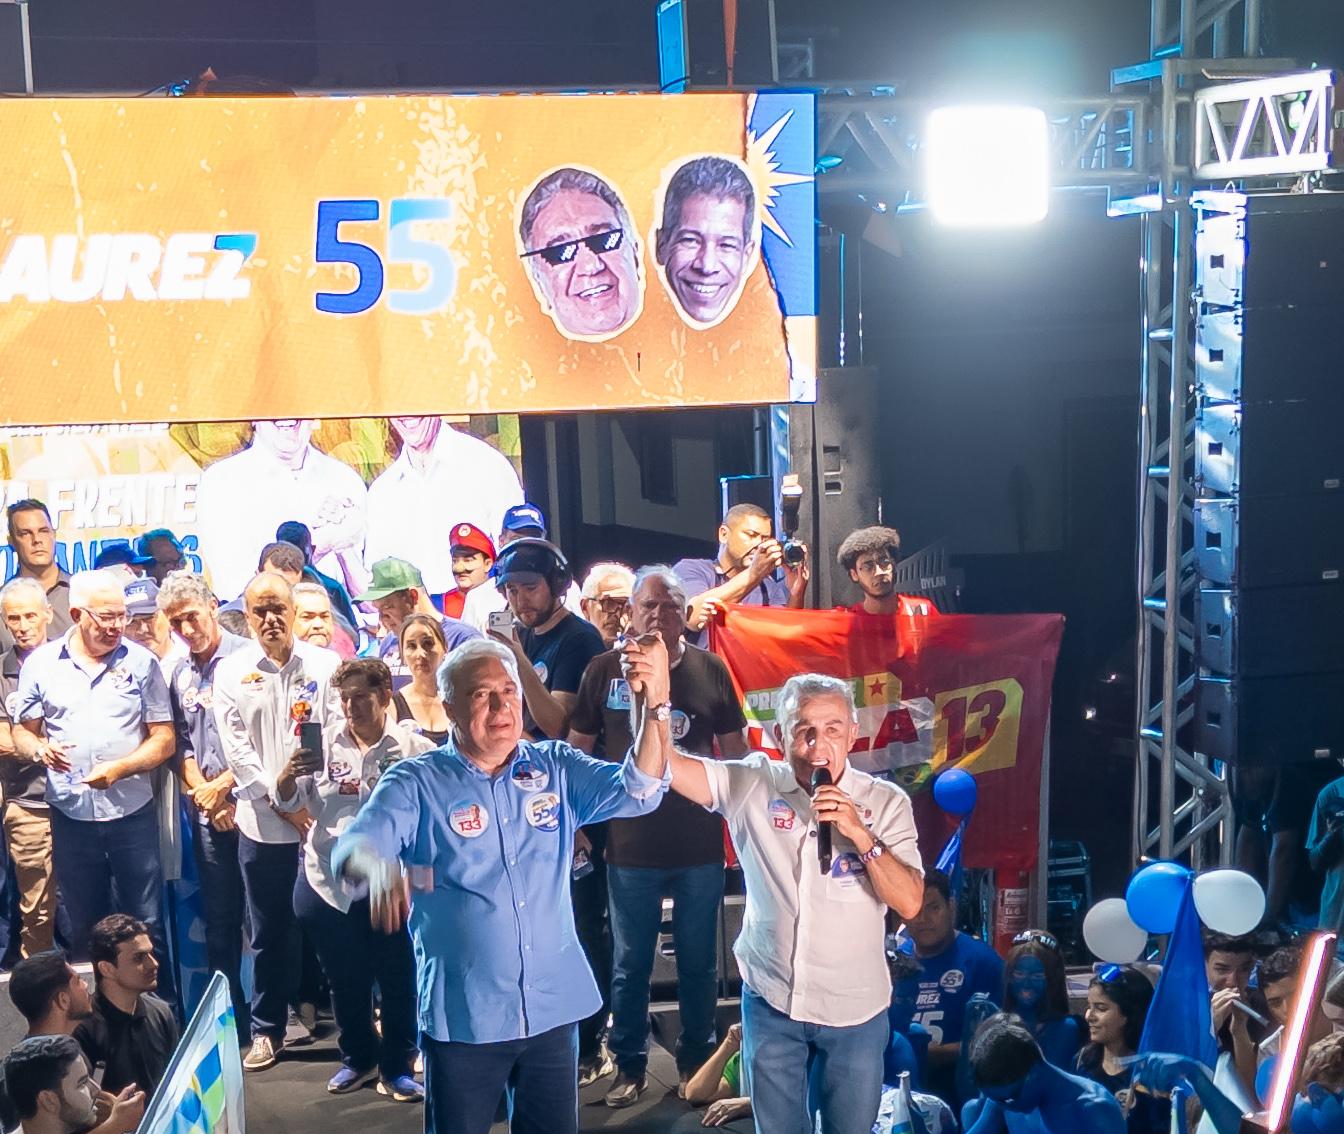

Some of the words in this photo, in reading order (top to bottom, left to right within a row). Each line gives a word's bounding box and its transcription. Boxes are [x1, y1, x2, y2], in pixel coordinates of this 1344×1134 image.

[313, 199, 457, 316] 55
[49, 474, 201, 530] FRENTE
[941, 689, 1007, 762] 13
[458, 819, 482, 832] 133
[533, 808, 550, 823] 55
[912, 1011, 944, 1045] 5
